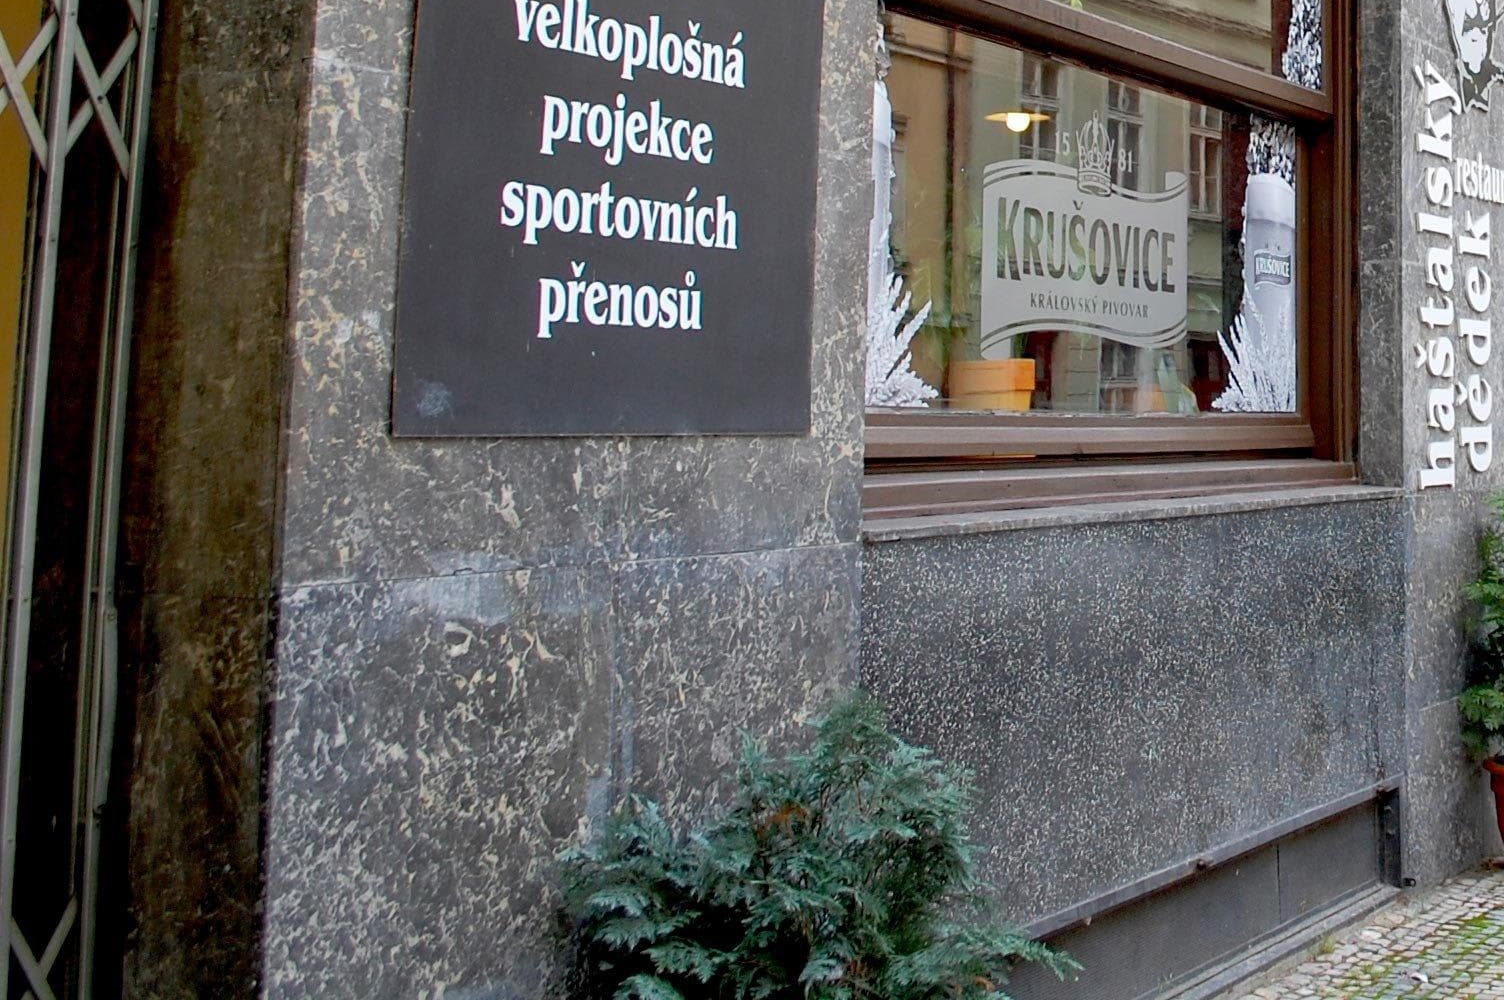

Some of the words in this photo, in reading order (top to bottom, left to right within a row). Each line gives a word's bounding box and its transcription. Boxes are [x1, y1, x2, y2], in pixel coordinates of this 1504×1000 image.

[539, 93, 713, 166] projekce
[1055, 130, 1071, 156] 15
[1119, 148, 1133, 174] 81
[500, 181, 738, 250] sportovních
[996, 196, 1176, 294] KRUŠOVICE
[537, 260, 702, 339] přenosů
[1030, 292, 1097, 313] KRÁLOVSKÝ
[1102, 300, 1149, 318] PIVOVAR
[1413, 59, 1462, 491] haštalský
[1455, 210, 1493, 473] dědek
